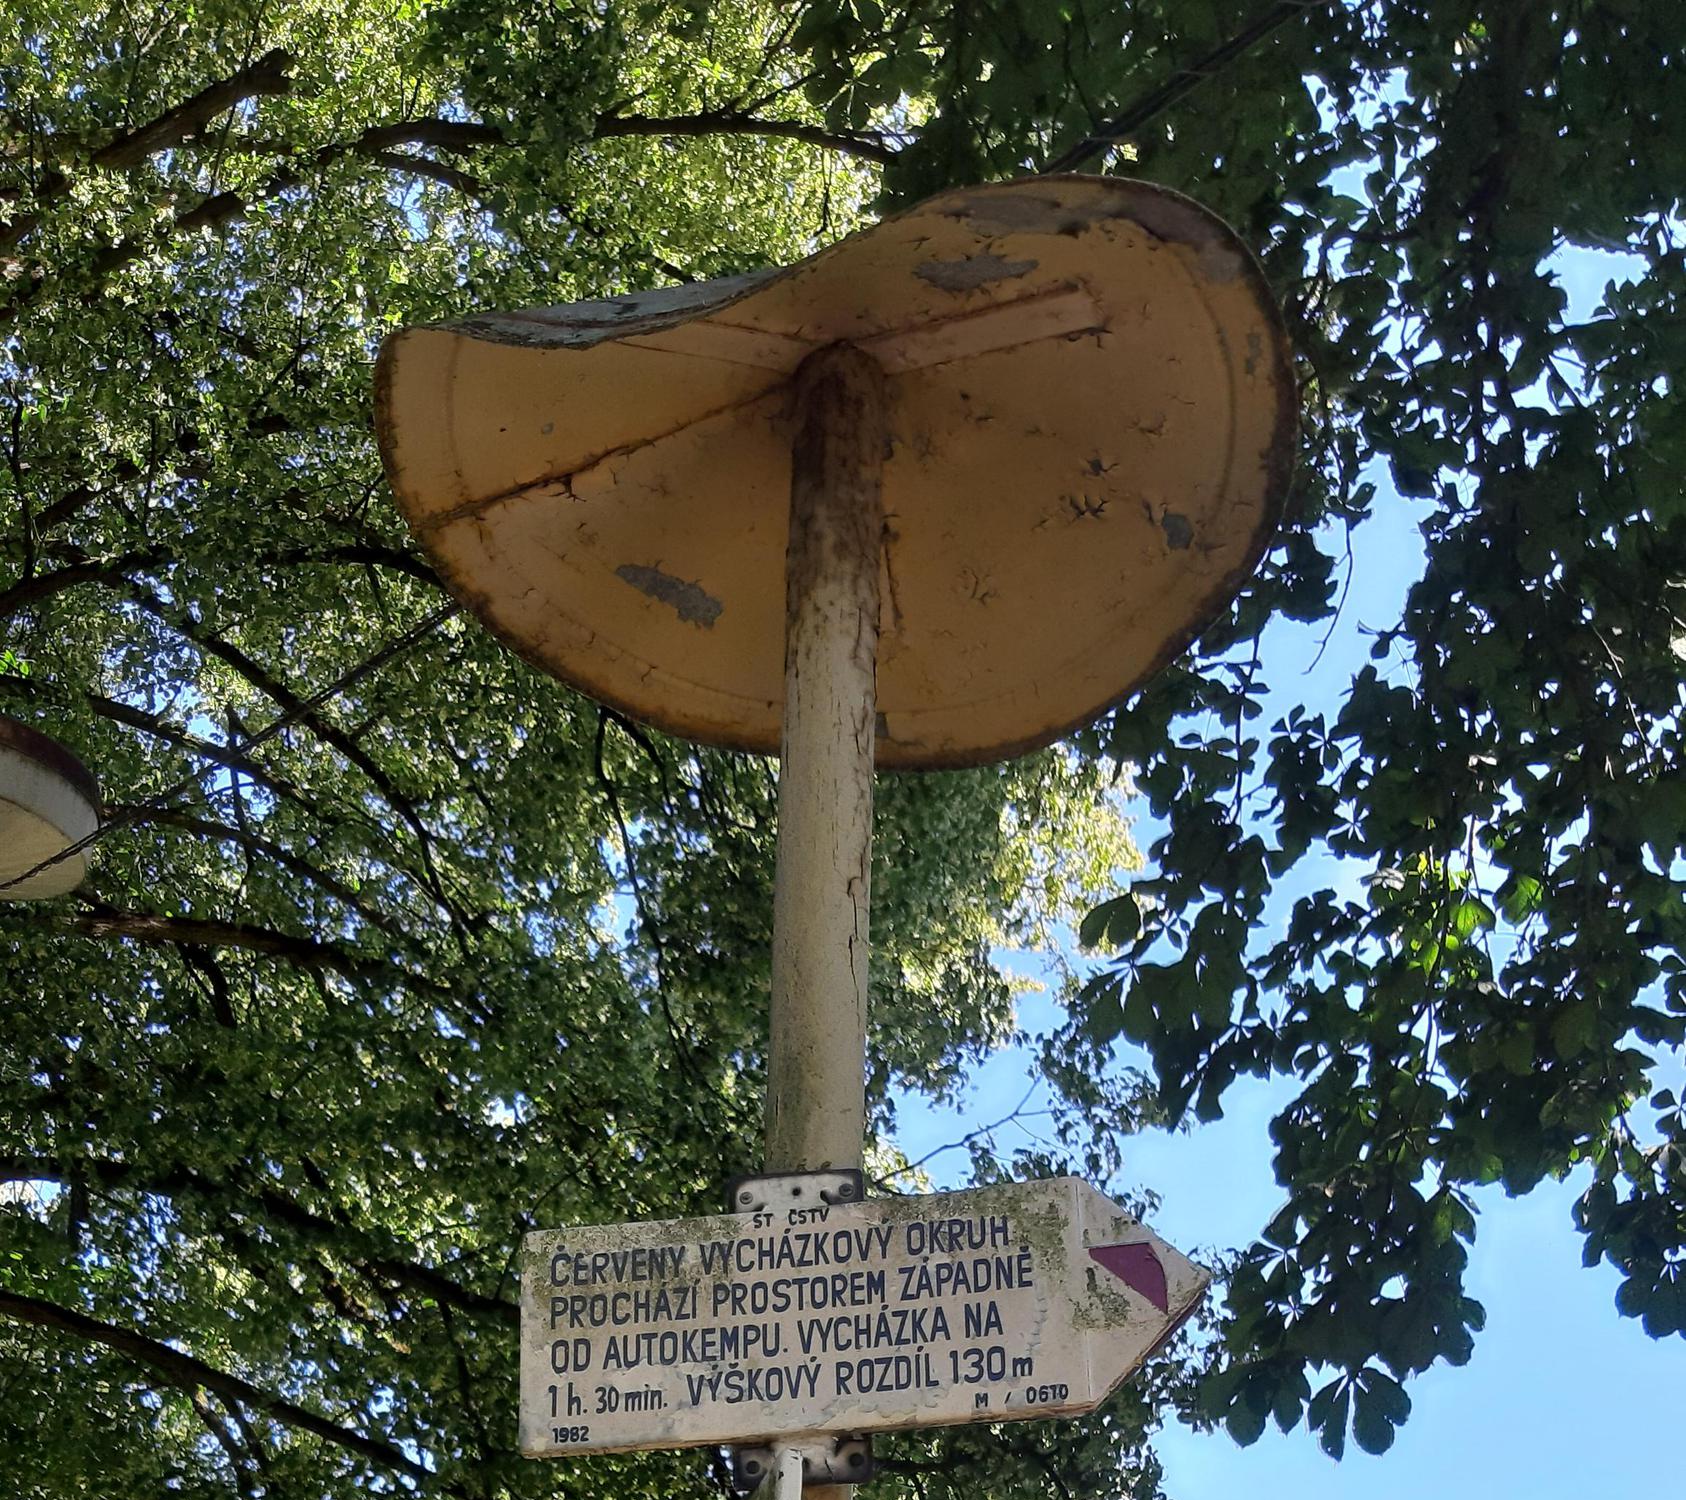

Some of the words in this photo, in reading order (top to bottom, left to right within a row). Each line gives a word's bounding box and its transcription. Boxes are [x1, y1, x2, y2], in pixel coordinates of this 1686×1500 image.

[753, 1213, 774, 1228] ST
[907, 1216, 1009, 1256] OKRUH
[551, 1279, 701, 1330] PROCHÁZÍ
[712, 1271, 885, 1317] PROSTOREM
[899, 1246, 1034, 1299] ZÁPADNĚ
[551, 1338, 591, 1374] OD
[603, 1323, 789, 1370] AUTOKEMPU.
[798, 1305, 951, 1355] VYCHÁZKA
[964, 1301, 1004, 1338] NA
[595, 1386, 619, 1414] 30
[624, 1384, 668, 1412] min.
[687, 1356, 822, 1406] VÝŠKOVÝ
[836, 1346, 939, 1395] ROZDÍL
[949, 1347, 1006, 1384] 130
[1012, 1355, 1033, 1377] m
[552, 1425, 590, 1443] 1982
